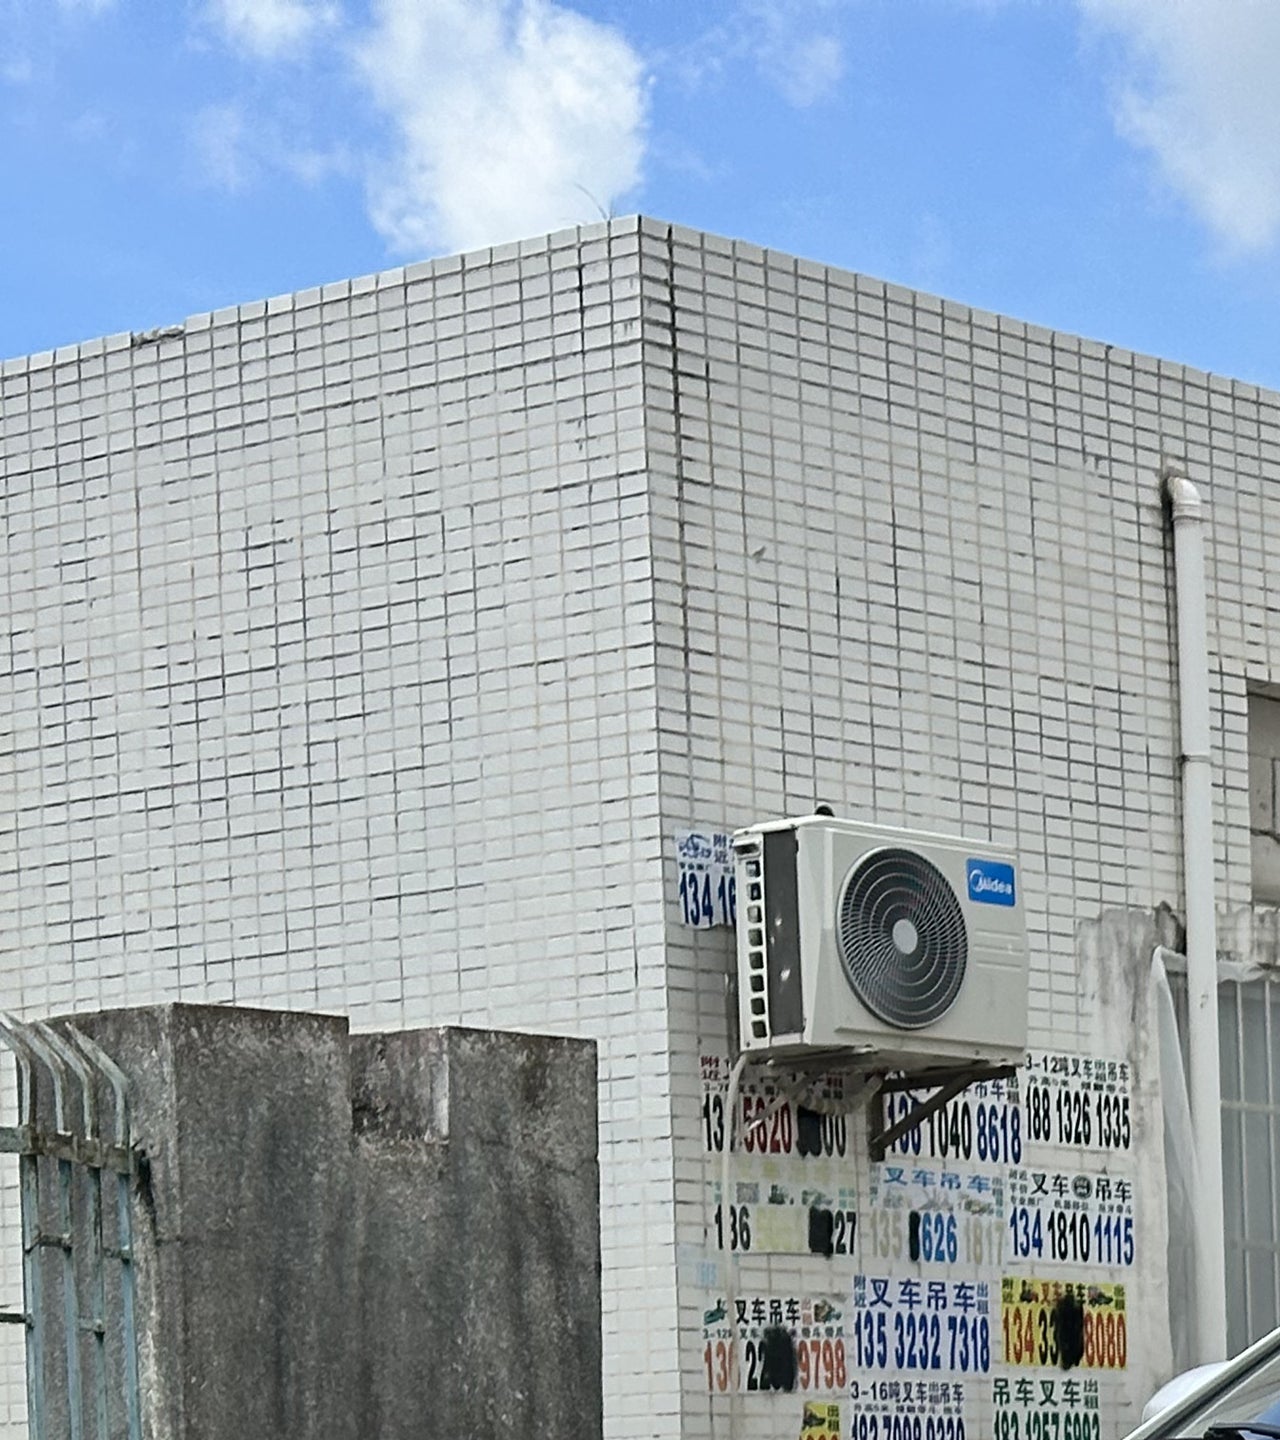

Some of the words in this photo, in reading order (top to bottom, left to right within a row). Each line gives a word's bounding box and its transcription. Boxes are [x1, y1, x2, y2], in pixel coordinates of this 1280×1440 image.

[680, 872, 713, 926] 134
[970, 869, 1012, 895] Midea
[977, 1102, 1021, 1165] 8618
[1026, 1085, 1051, 1142] 188
[1056, 1089, 1091, 1146] 1326
[1096, 1093, 1130, 1150] 1335
[908, 1210, 958, 1263] 626
[1010, 1206, 1043, 1258] 134
[1047, 1210, 1090, 1262] 1810
[1094, 1214, 1134, 1265] 1115
[735, 1297, 801, 1326] 叉车吊车
[869, 1278, 975, 1314] 叉车吊车
[798, 1338, 846, 1390] 9798
[855, 1310, 888, 1369] 135
[894, 1311, 941, 1370] 3232
[948, 1315, 990, 1373] 7318
[1003, 1307, 1035, 1364] 134
[1084, 1311, 1127, 1369] 8080
[993, 1377, 1082, 1409] 吊车叉车
